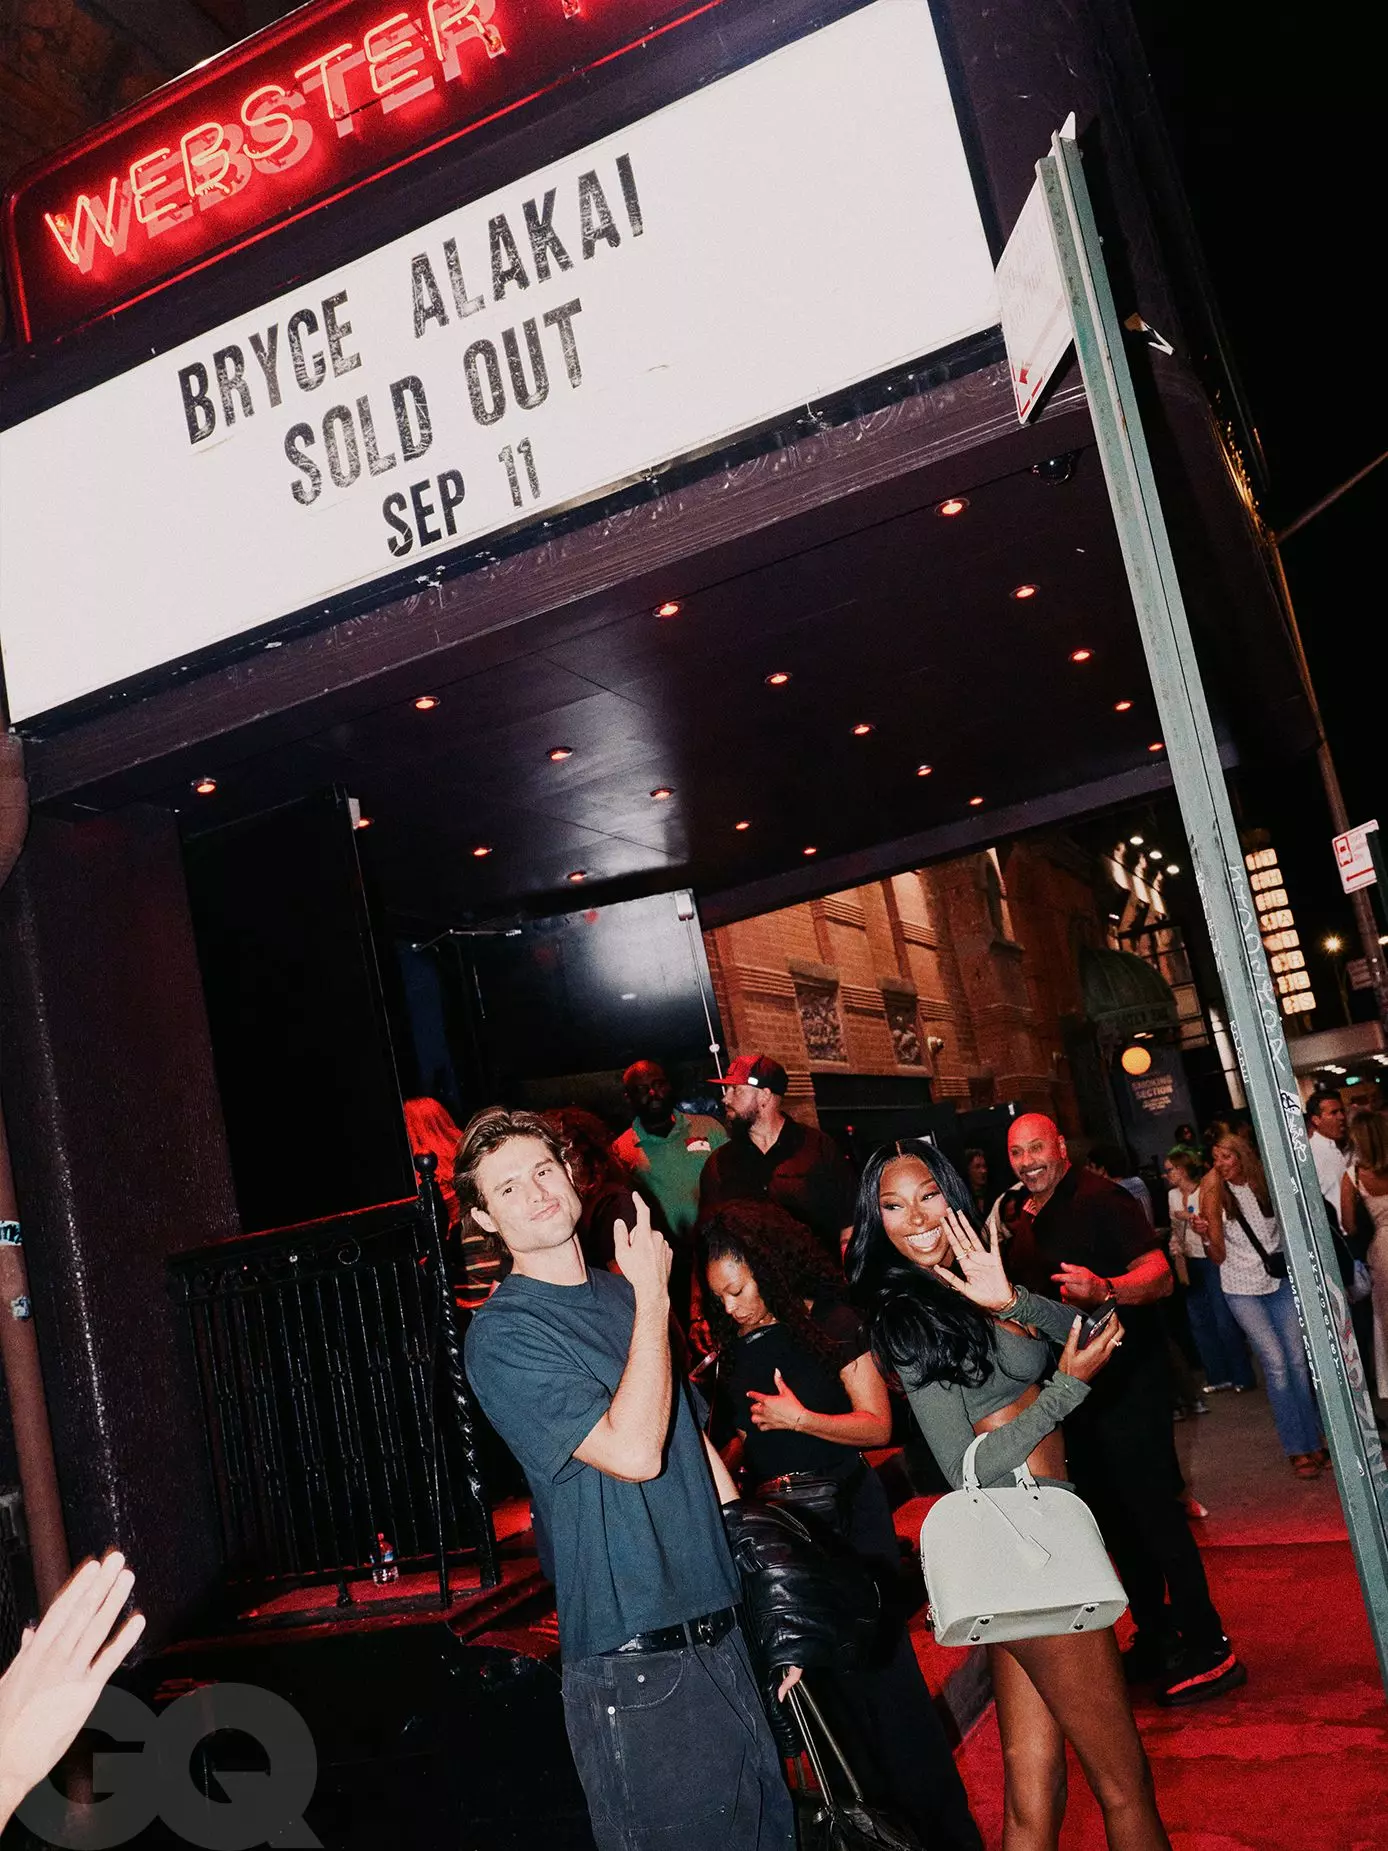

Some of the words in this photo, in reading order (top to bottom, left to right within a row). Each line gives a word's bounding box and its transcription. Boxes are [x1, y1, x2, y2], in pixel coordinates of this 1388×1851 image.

[45, 0, 506, 273] WEBSTER
[177, 289, 362, 444] BRYCE
[411, 152, 644, 339] ALAKAI
[284, 375, 433, 506] SOLD
[463, 297, 583, 426] OUT
[382, 469, 466, 558] SEP
[498, 437, 541, 508] 11
